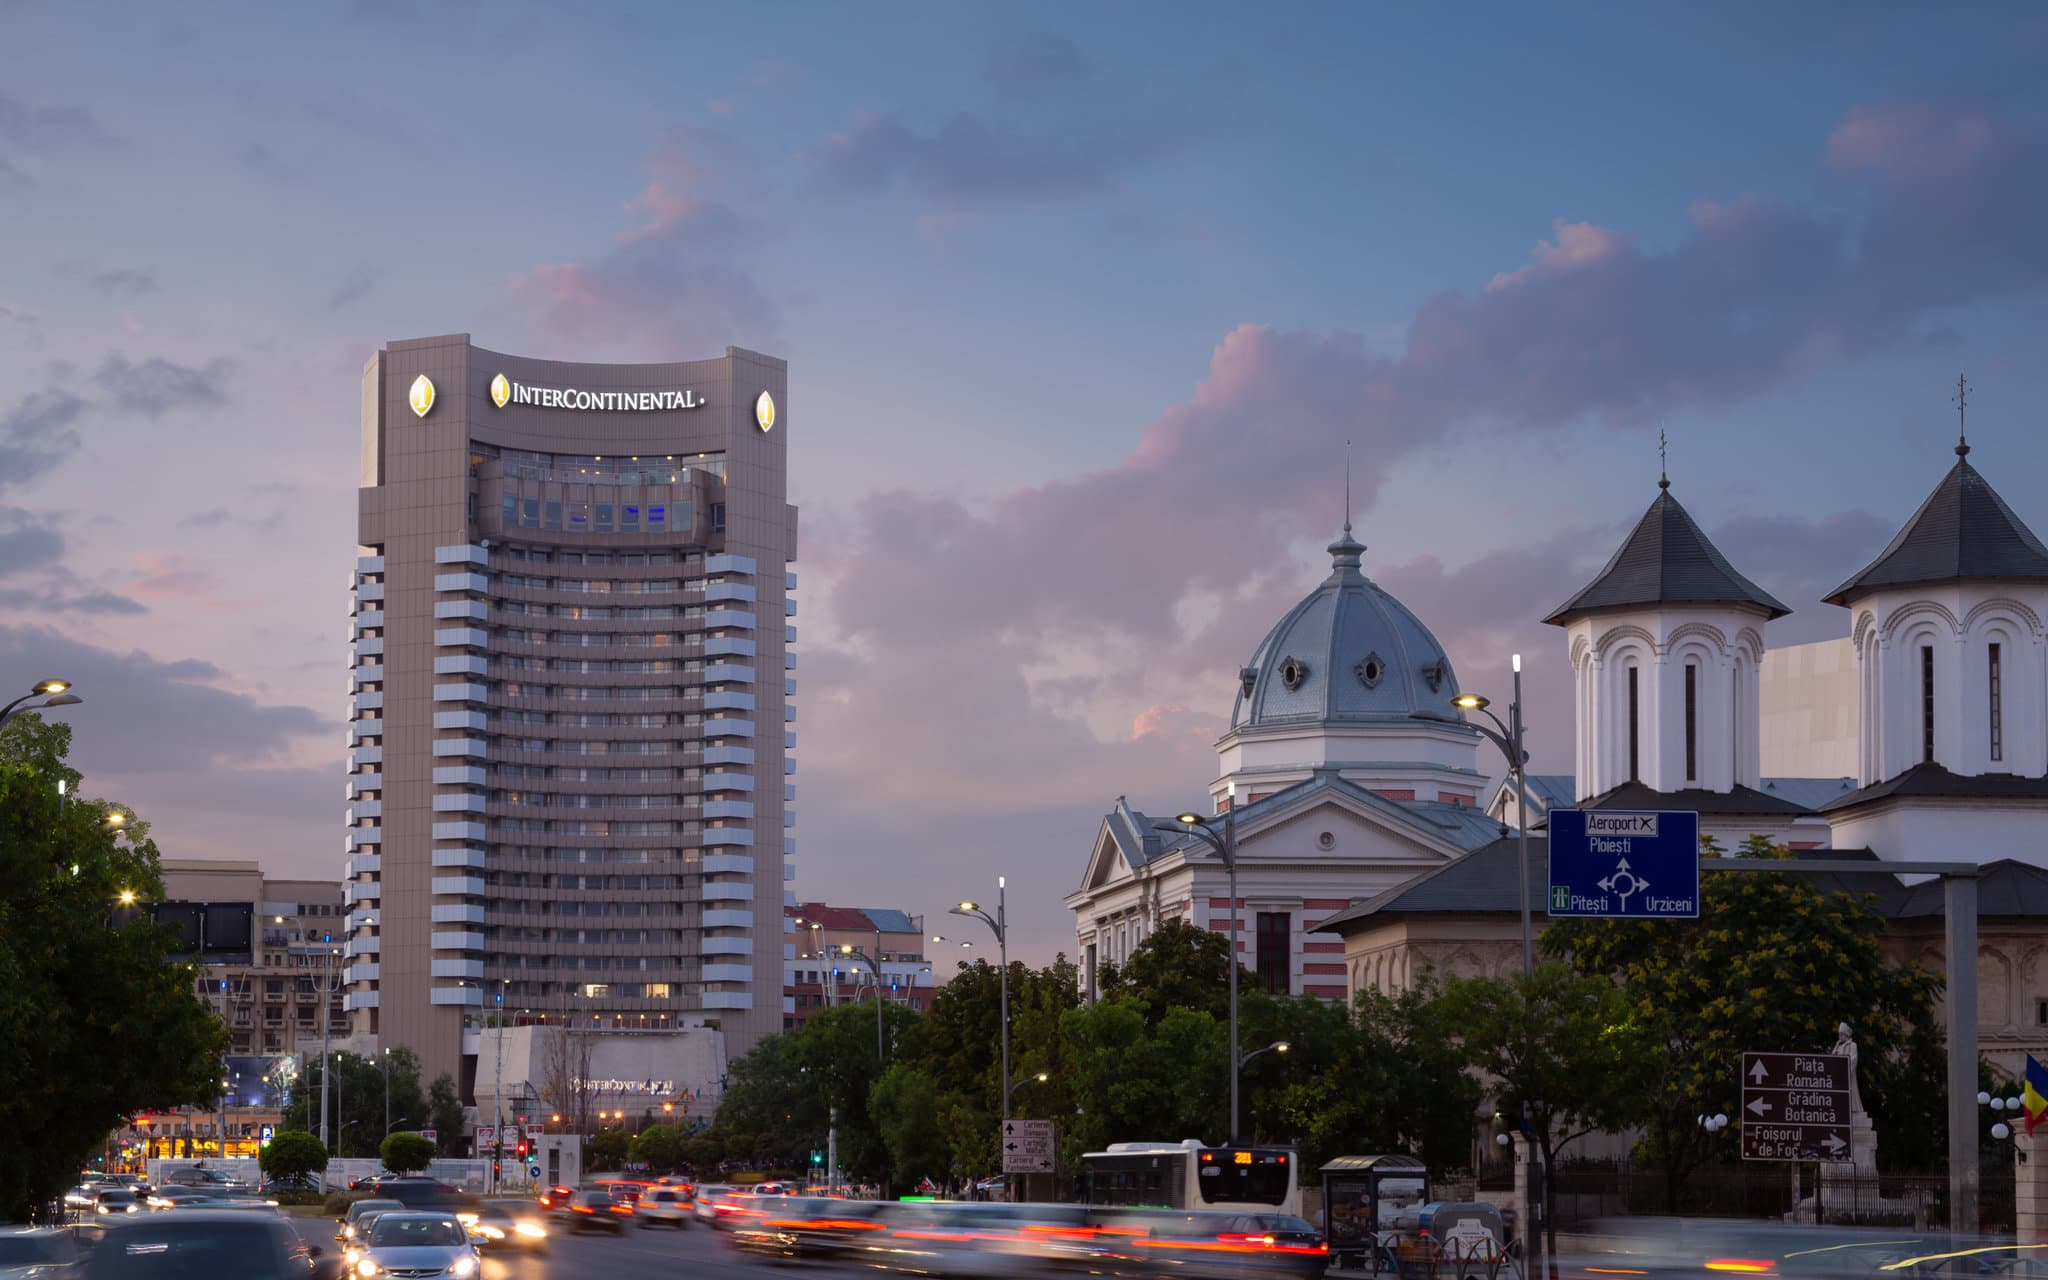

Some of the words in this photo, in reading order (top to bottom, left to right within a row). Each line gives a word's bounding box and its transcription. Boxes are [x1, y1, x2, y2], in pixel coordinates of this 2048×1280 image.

[1589, 815, 1637, 834] Aeroport
[1590, 837, 1631, 856] Ploiești
[1571, 895, 1609, 914] Pitești
[1646, 895, 1692, 912] Urziceni
[1794, 1057, 1825, 1074] Piața
[583, 1079, 674, 1091] INTERCONTNNAL
[1786, 1073, 1833, 1089] Romană
[1788, 1091, 1832, 1106] Grădina
[1785, 1107, 1836, 1123] Botanică
[1755, 1126, 1802, 1143] Foișorul
[1759, 1142, 1773, 1157] de
[1777, 1142, 1798, 1157] Foc
